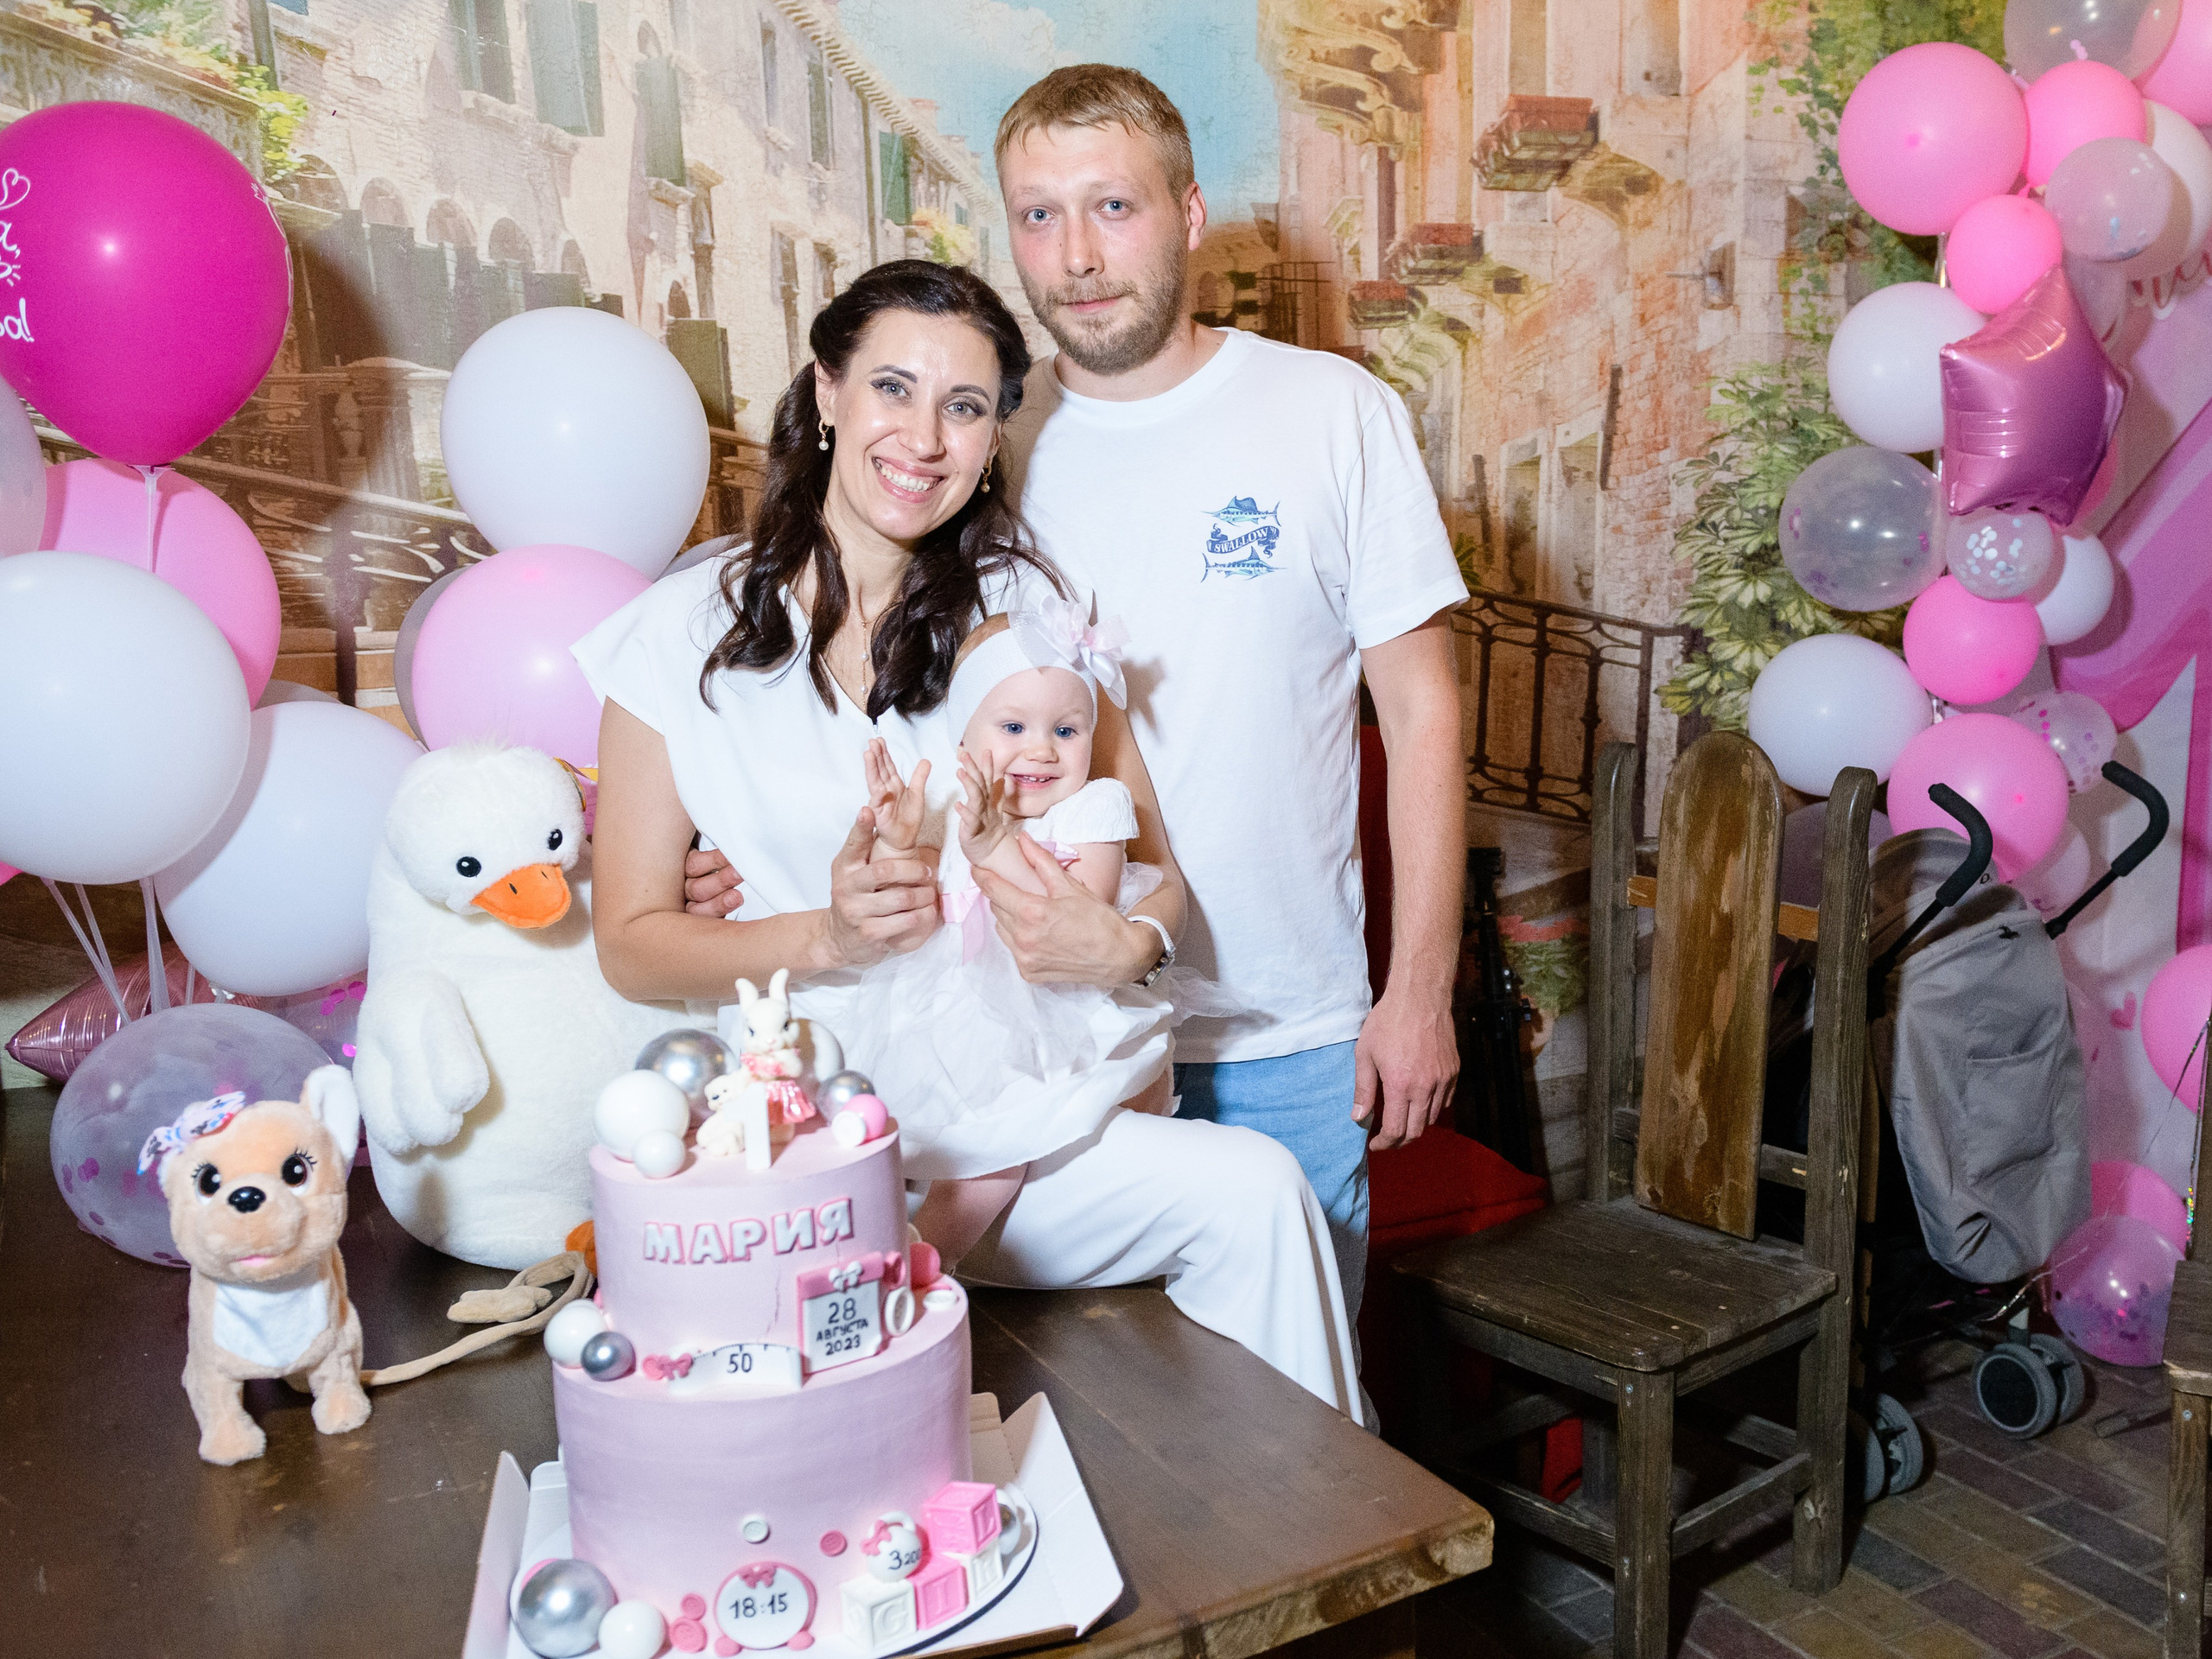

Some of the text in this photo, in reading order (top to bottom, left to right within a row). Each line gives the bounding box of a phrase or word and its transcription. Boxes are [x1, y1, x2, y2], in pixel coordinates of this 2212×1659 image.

[643, 1197, 855, 1265] МАРИЯ
[828, 1297, 857, 1325] 28
[816, 1318, 869, 1343] АВГУСТА
[825, 1334, 861, 1357] 2023
[726, 1352, 753, 1375] 50
[728, 1592, 788, 1619] 18:15
